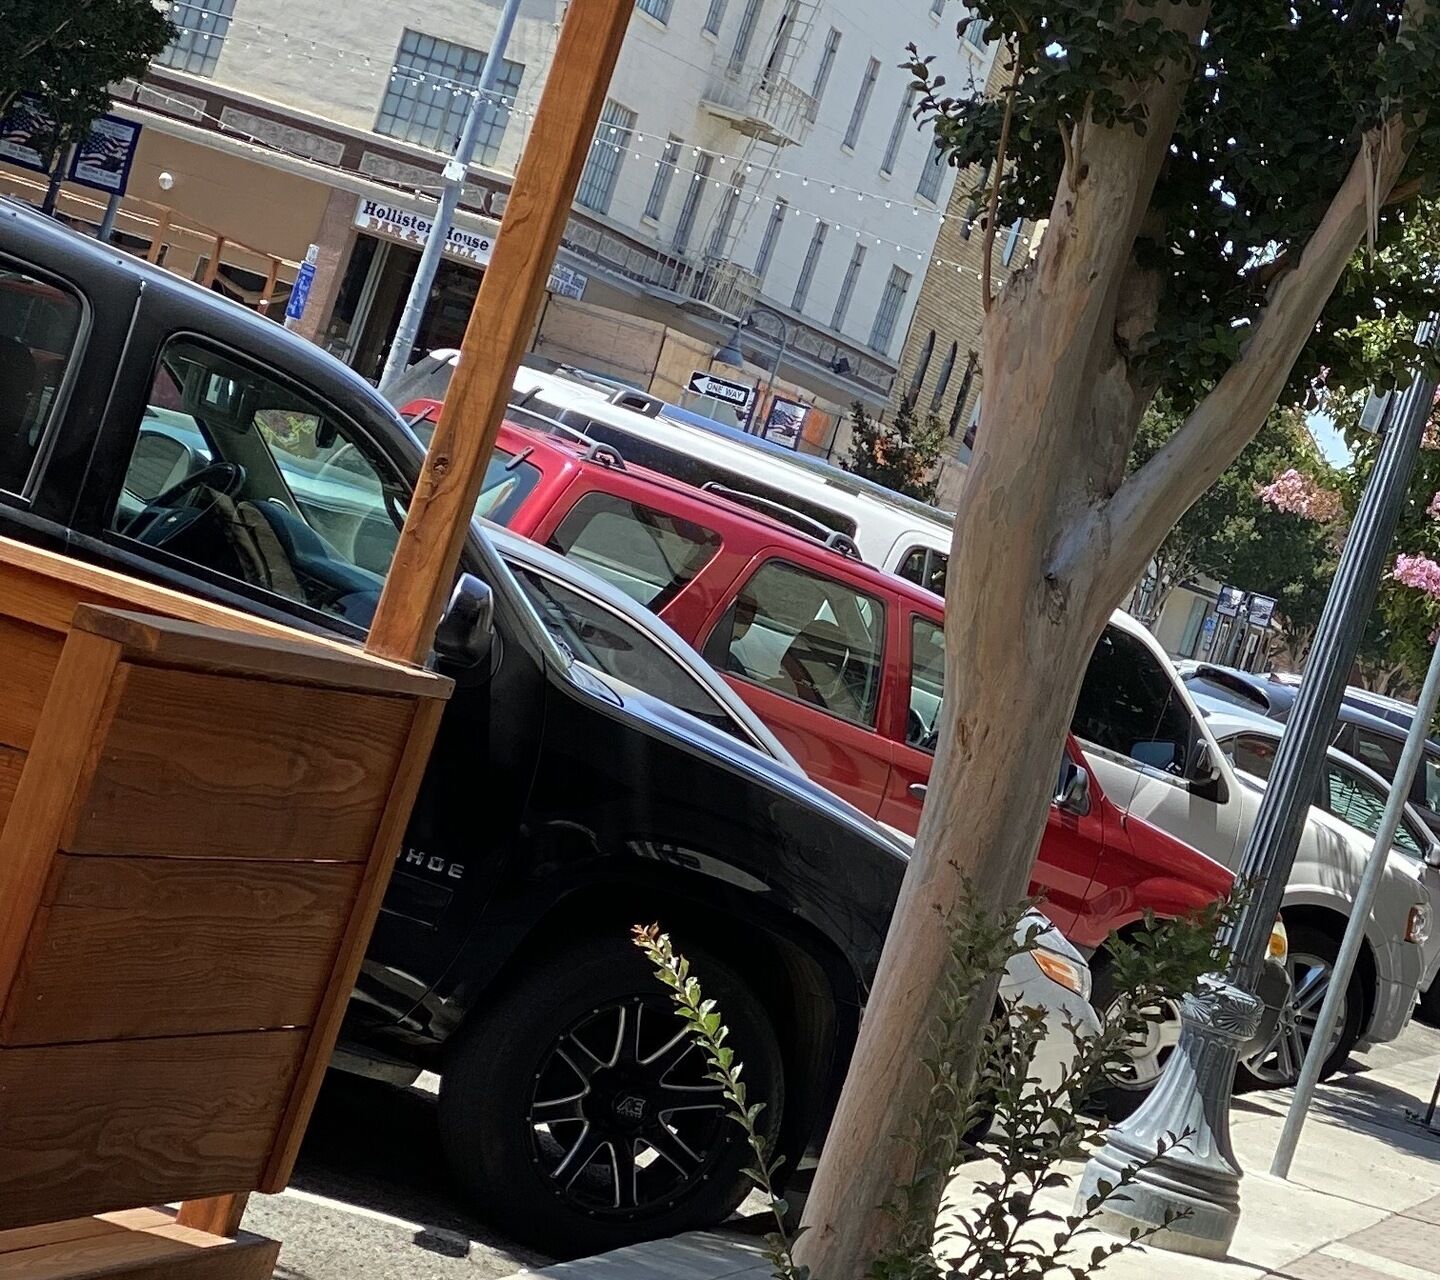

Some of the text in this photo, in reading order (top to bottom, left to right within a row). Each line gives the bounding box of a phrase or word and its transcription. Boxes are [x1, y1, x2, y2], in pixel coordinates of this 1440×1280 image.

[363, 201, 433, 234] Hollister
[367, 217, 402, 238] BAR
[406, 230, 419, 243] &
[706, 382, 744, 400] ONE WAY
[397, 847, 465, 879] HOE
